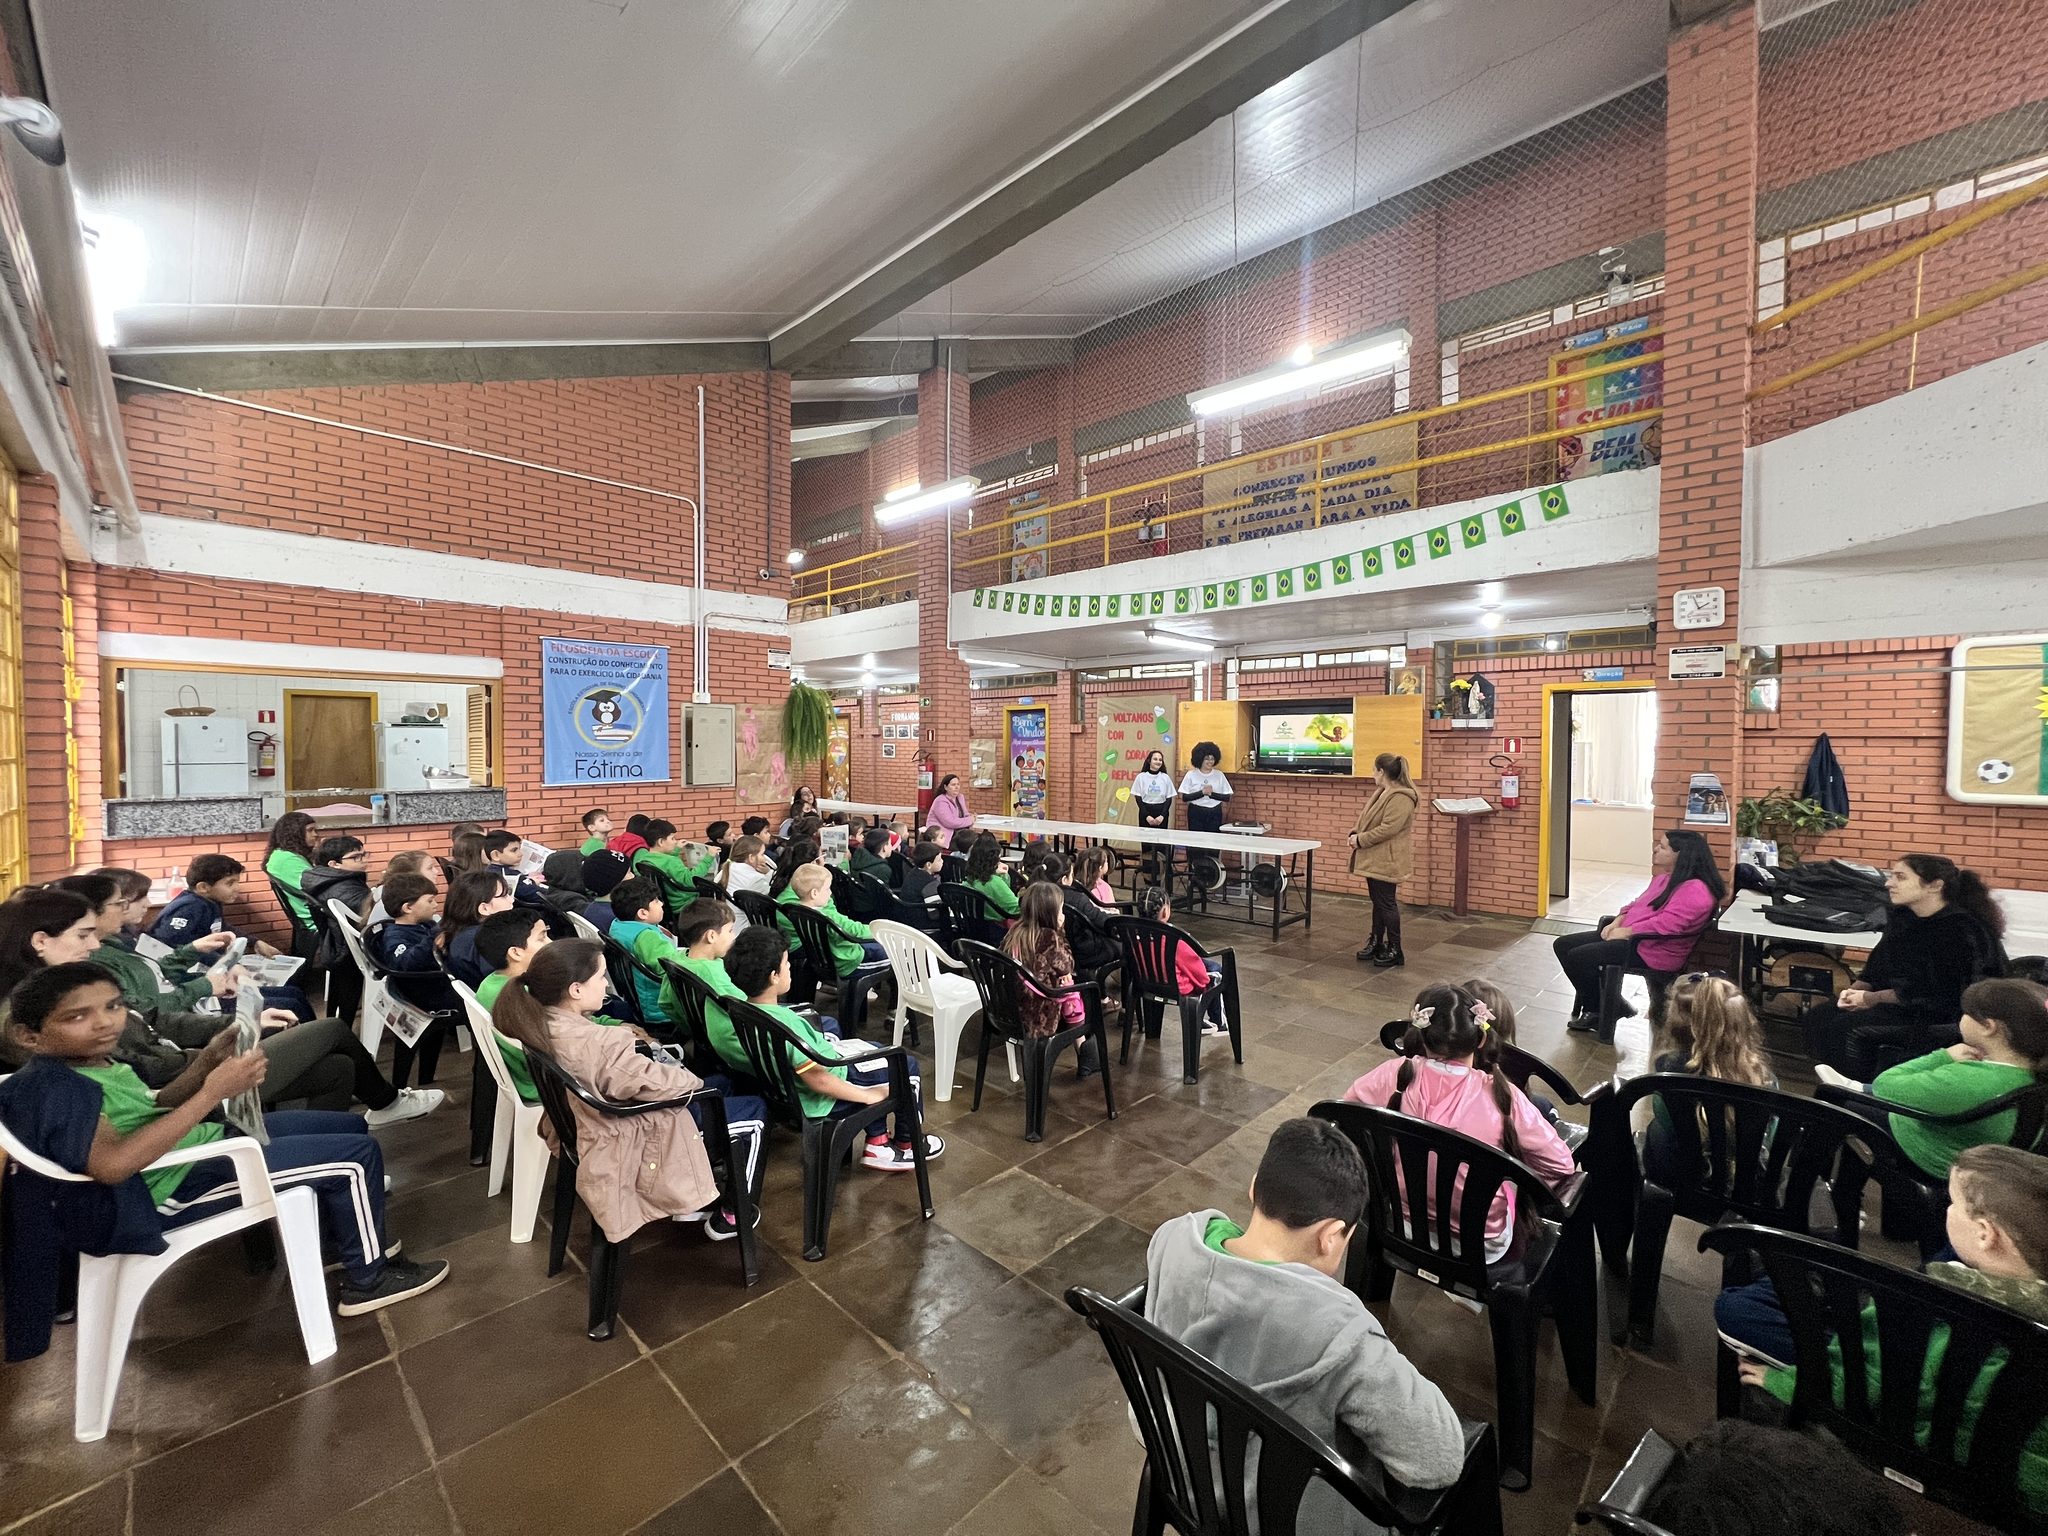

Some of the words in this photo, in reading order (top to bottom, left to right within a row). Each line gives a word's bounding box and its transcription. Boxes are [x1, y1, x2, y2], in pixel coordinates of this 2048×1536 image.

[1590, 432, 1636, 462] BEM
[1218, 519, 1226, 529] E
[1302, 502, 1312, 513] A
[1321, 492, 1356, 508] ADA
[1205, 538, 1213, 548] E
[1355, 507, 1366, 518] A
[551, 643, 604, 655] FILOSOFIA
[606, 648, 620, 656] DA
[548, 656, 597, 667] CONSTRUÇÃO
[611, 660, 663, 670] CONHECIMNTO
[550, 667, 570, 676] PARA
[615, 671, 624, 679] DA
[1113, 712, 1154, 723] VOLTAMOS
[1107, 730, 1124, 740] COM
[1136, 730, 1143, 740] O
[600, 750, 631, 758] Senhora
[1125, 749, 1150, 761] CORA
[575, 759, 643, 779] Fátima
[1111, 769, 1140, 781] REPLE
